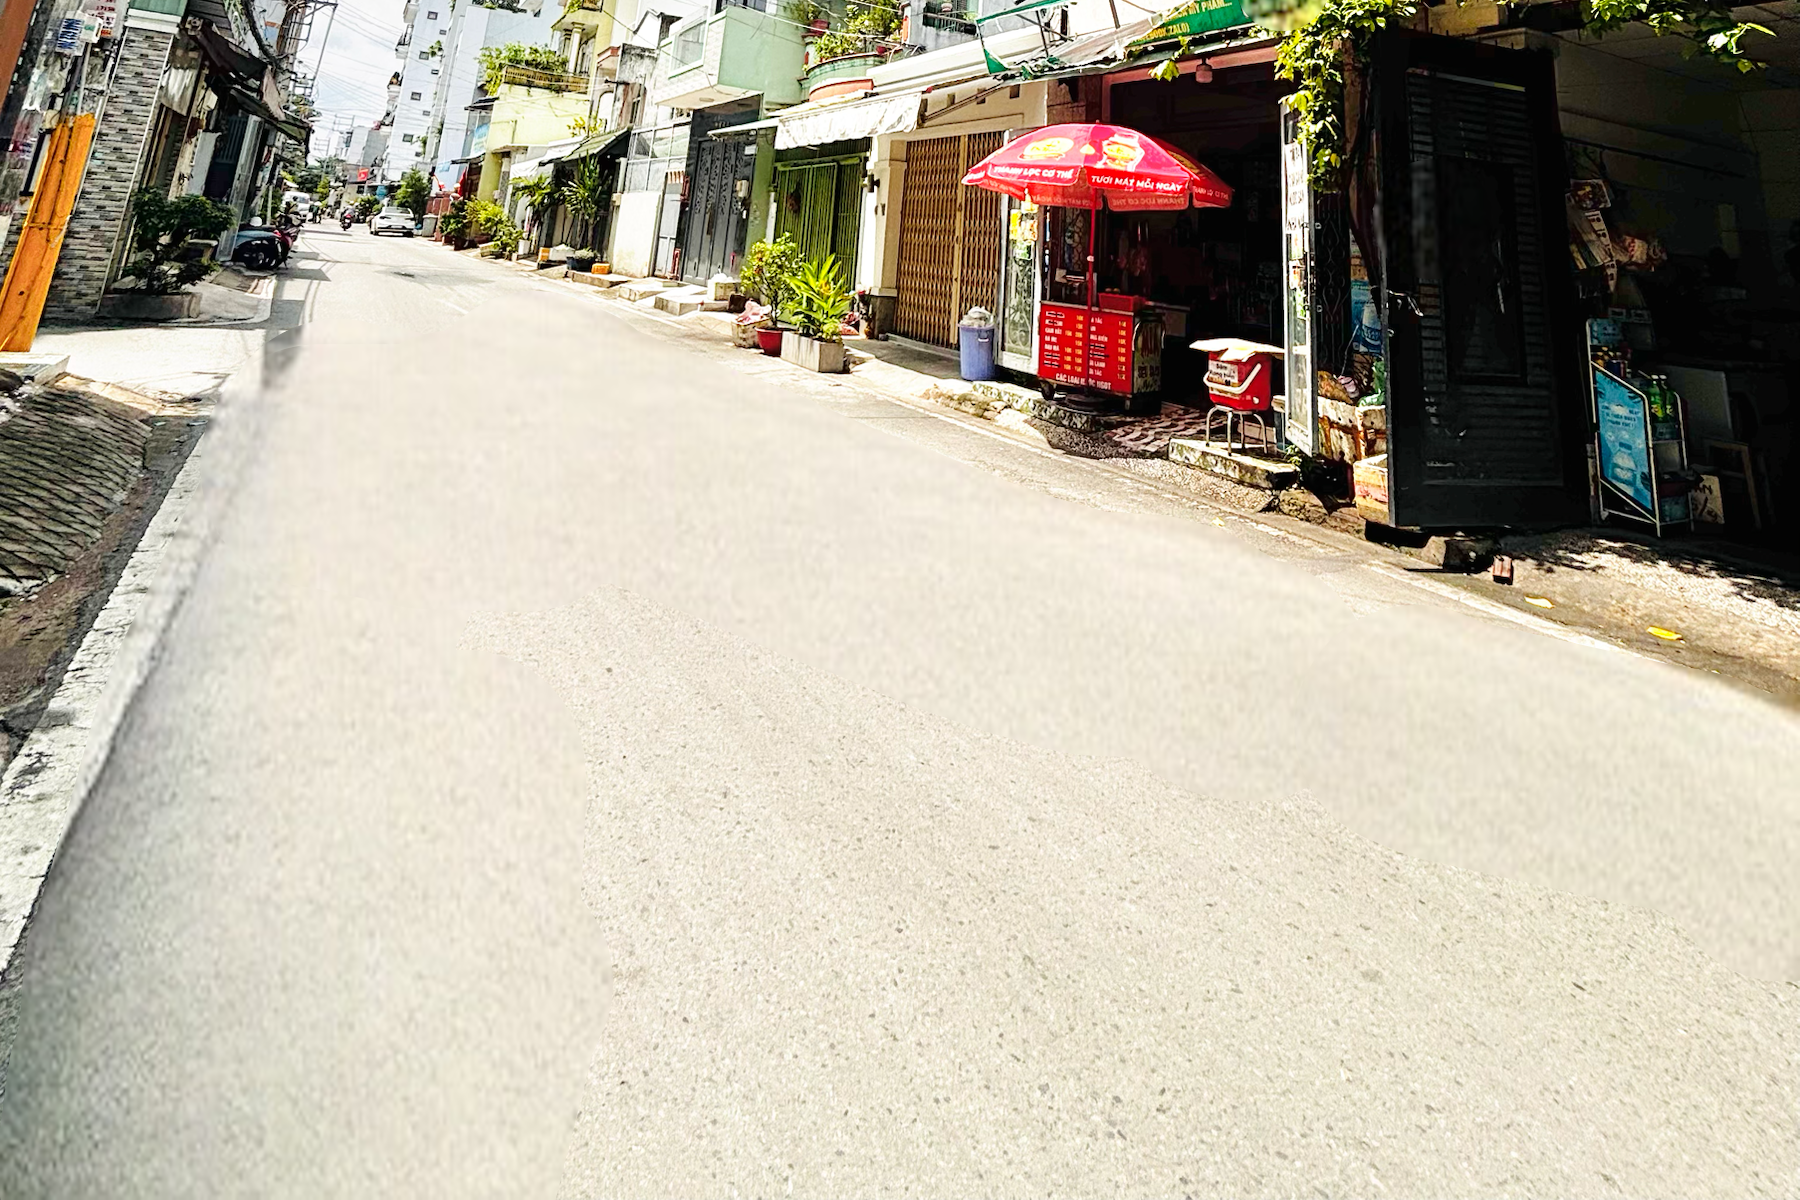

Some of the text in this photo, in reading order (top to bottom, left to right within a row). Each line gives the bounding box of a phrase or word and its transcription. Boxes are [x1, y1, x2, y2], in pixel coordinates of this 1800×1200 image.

[993, 166, 1023, 175] THANH
[1023, 168, 1041, 177] LỌC
[1042, 169, 1056, 178] CƠ
[1056, 168, 1074, 179] THỂ
[1091, 175, 1183, 192] TƯƠI MÁT MỖI NGÀY
